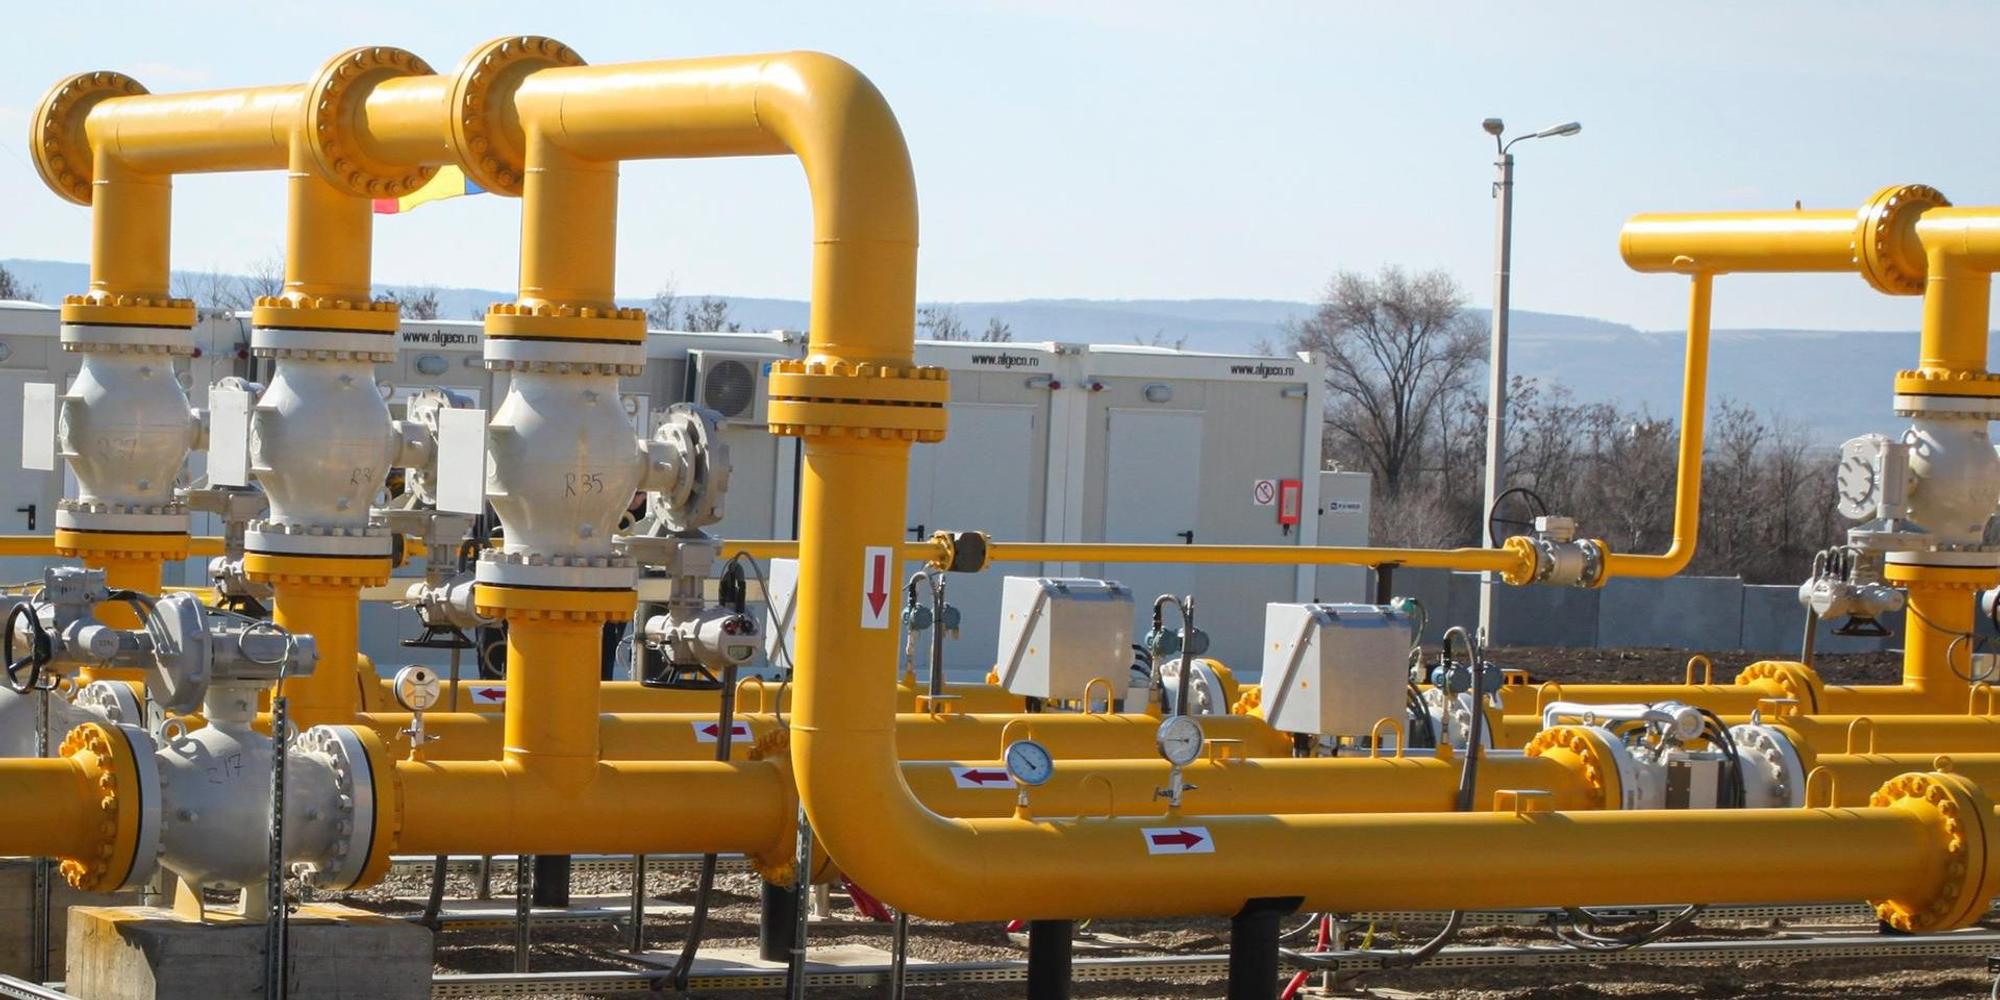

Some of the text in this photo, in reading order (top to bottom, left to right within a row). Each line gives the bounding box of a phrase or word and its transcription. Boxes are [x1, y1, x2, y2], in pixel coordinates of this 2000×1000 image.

[403, 330, 478, 346] www.algeco.ro
[972, 352, 1039, 368] www.algeco.ro
[1231, 362, 1294, 378] www.algeco.ro
[564, 472, 604, 498] R35
